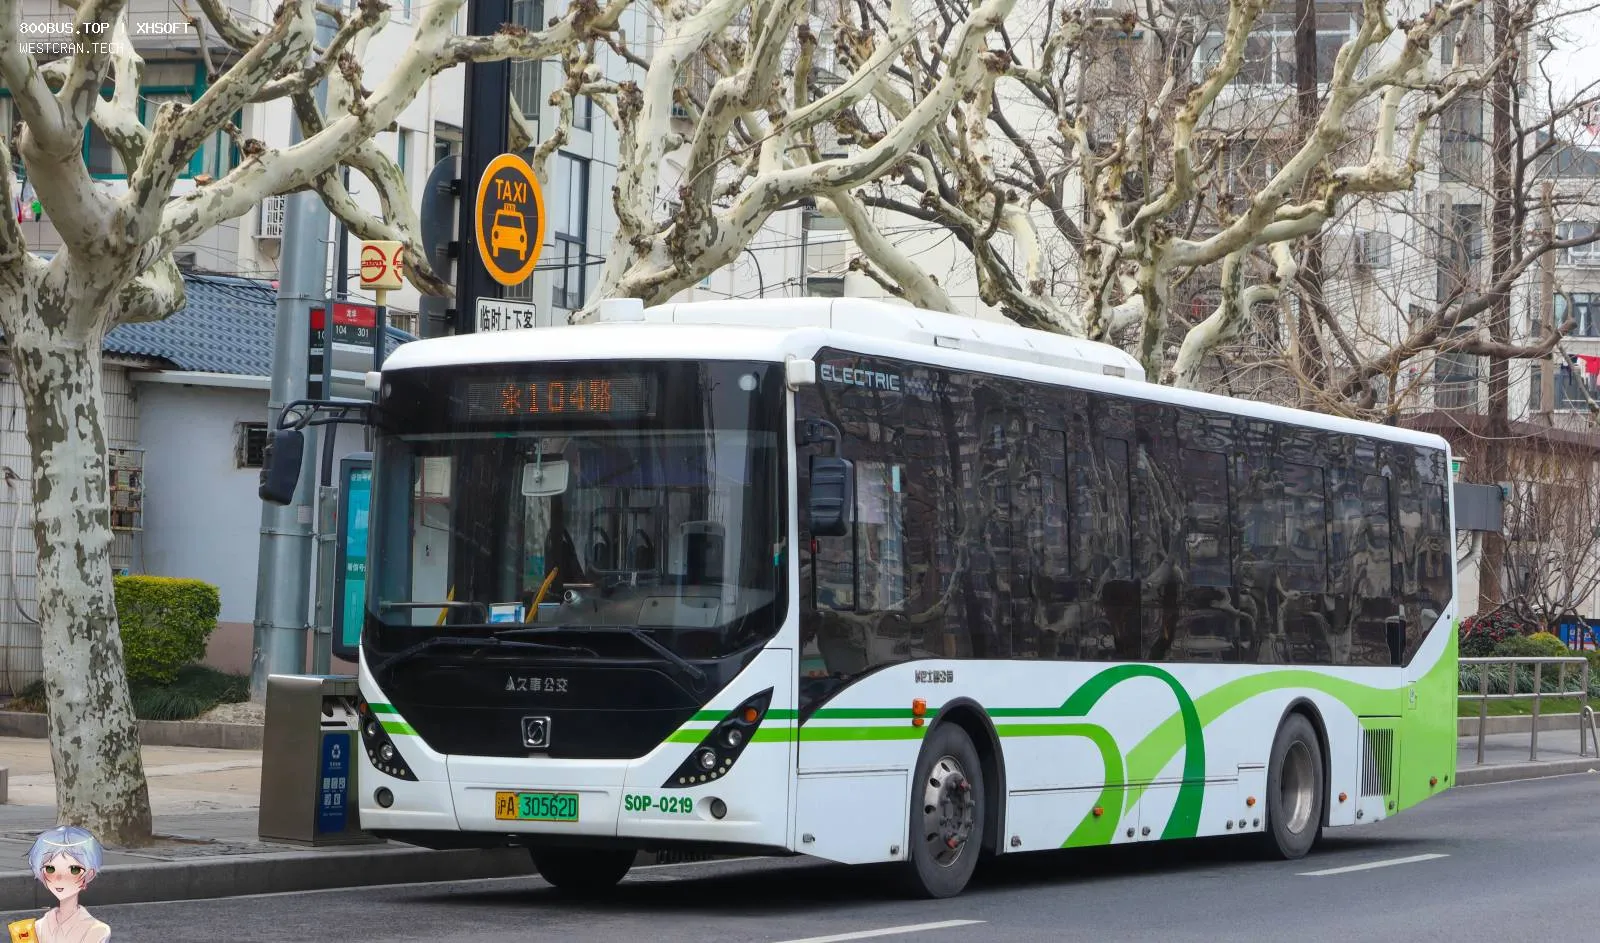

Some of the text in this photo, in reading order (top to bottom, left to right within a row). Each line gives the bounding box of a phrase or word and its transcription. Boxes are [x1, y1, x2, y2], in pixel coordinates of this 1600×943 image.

[495, 178, 527, 204] TAXI
[335, 325, 369, 338] 104 301
[480, 306, 533, 332] 临时上下客
[821, 364, 900, 391] ELECTRIC
[516, 677, 568, 692] 久事公交
